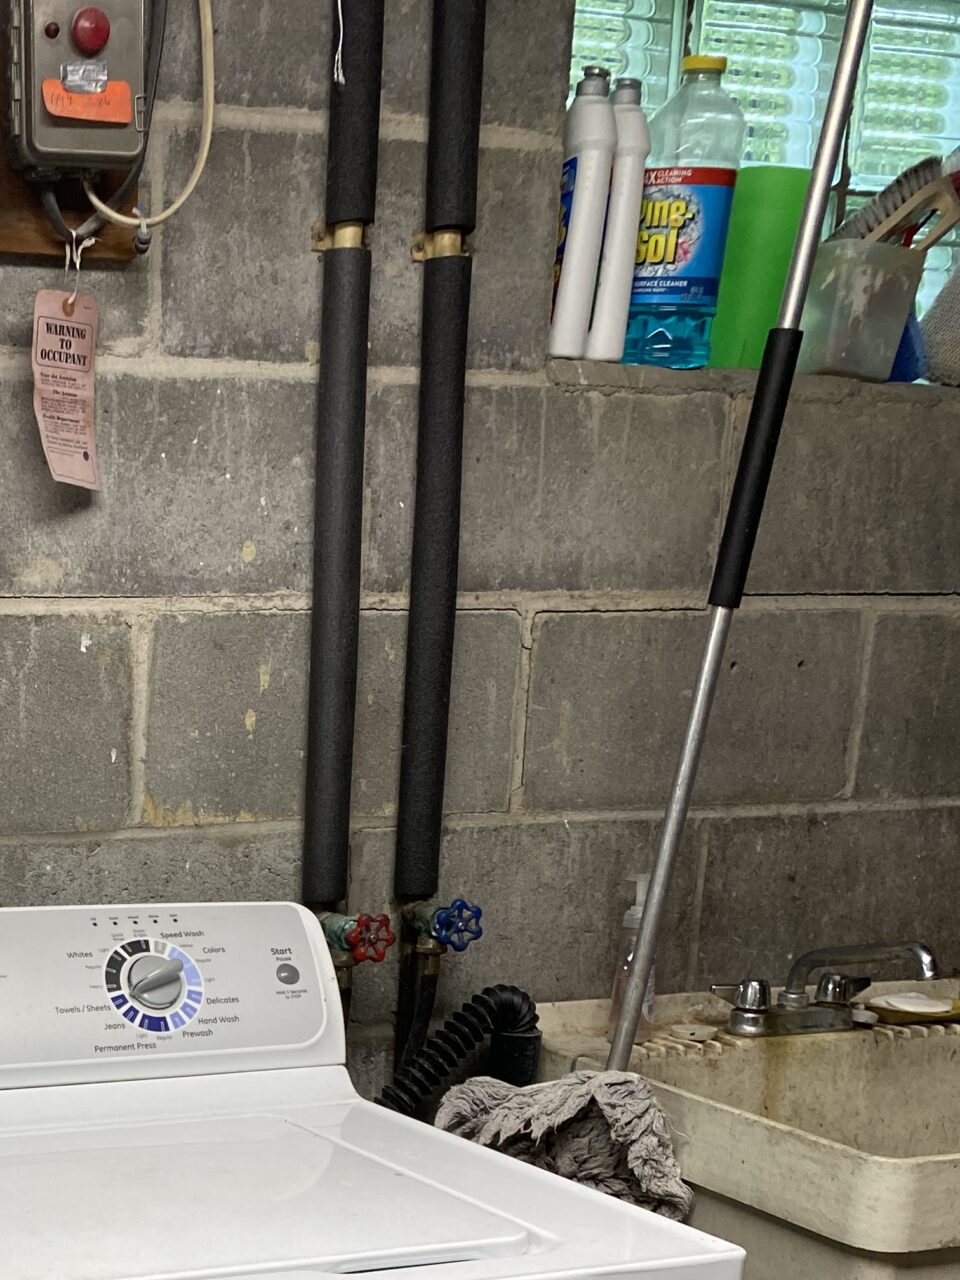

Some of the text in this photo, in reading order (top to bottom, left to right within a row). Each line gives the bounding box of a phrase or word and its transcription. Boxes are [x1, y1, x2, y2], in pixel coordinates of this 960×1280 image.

[657, 169, 693, 177] CLEANING
[659, 279, 689, 287] CLEANER
[45, 322, 87, 340] WARNING
[59, 338, 72, 351] TO
[40, 348, 87, 366] OCCUPANT
[160, 931, 182, 939] Speed
[66, 951, 93, 959] Whites
[270, 947, 293, 955] Start
[206, 996, 240, 1005] Delicates
[54, 1006, 81, 1014] Towels
[86, 1004, 111, 1012] Sheets
[197, 1015, 240, 1025] Hand Wash
[104, 1022, 126, 1030] Jeans
[182, 1029, 213, 1038] Prewash
[94, 1042, 157, 1053] Permanent Press
